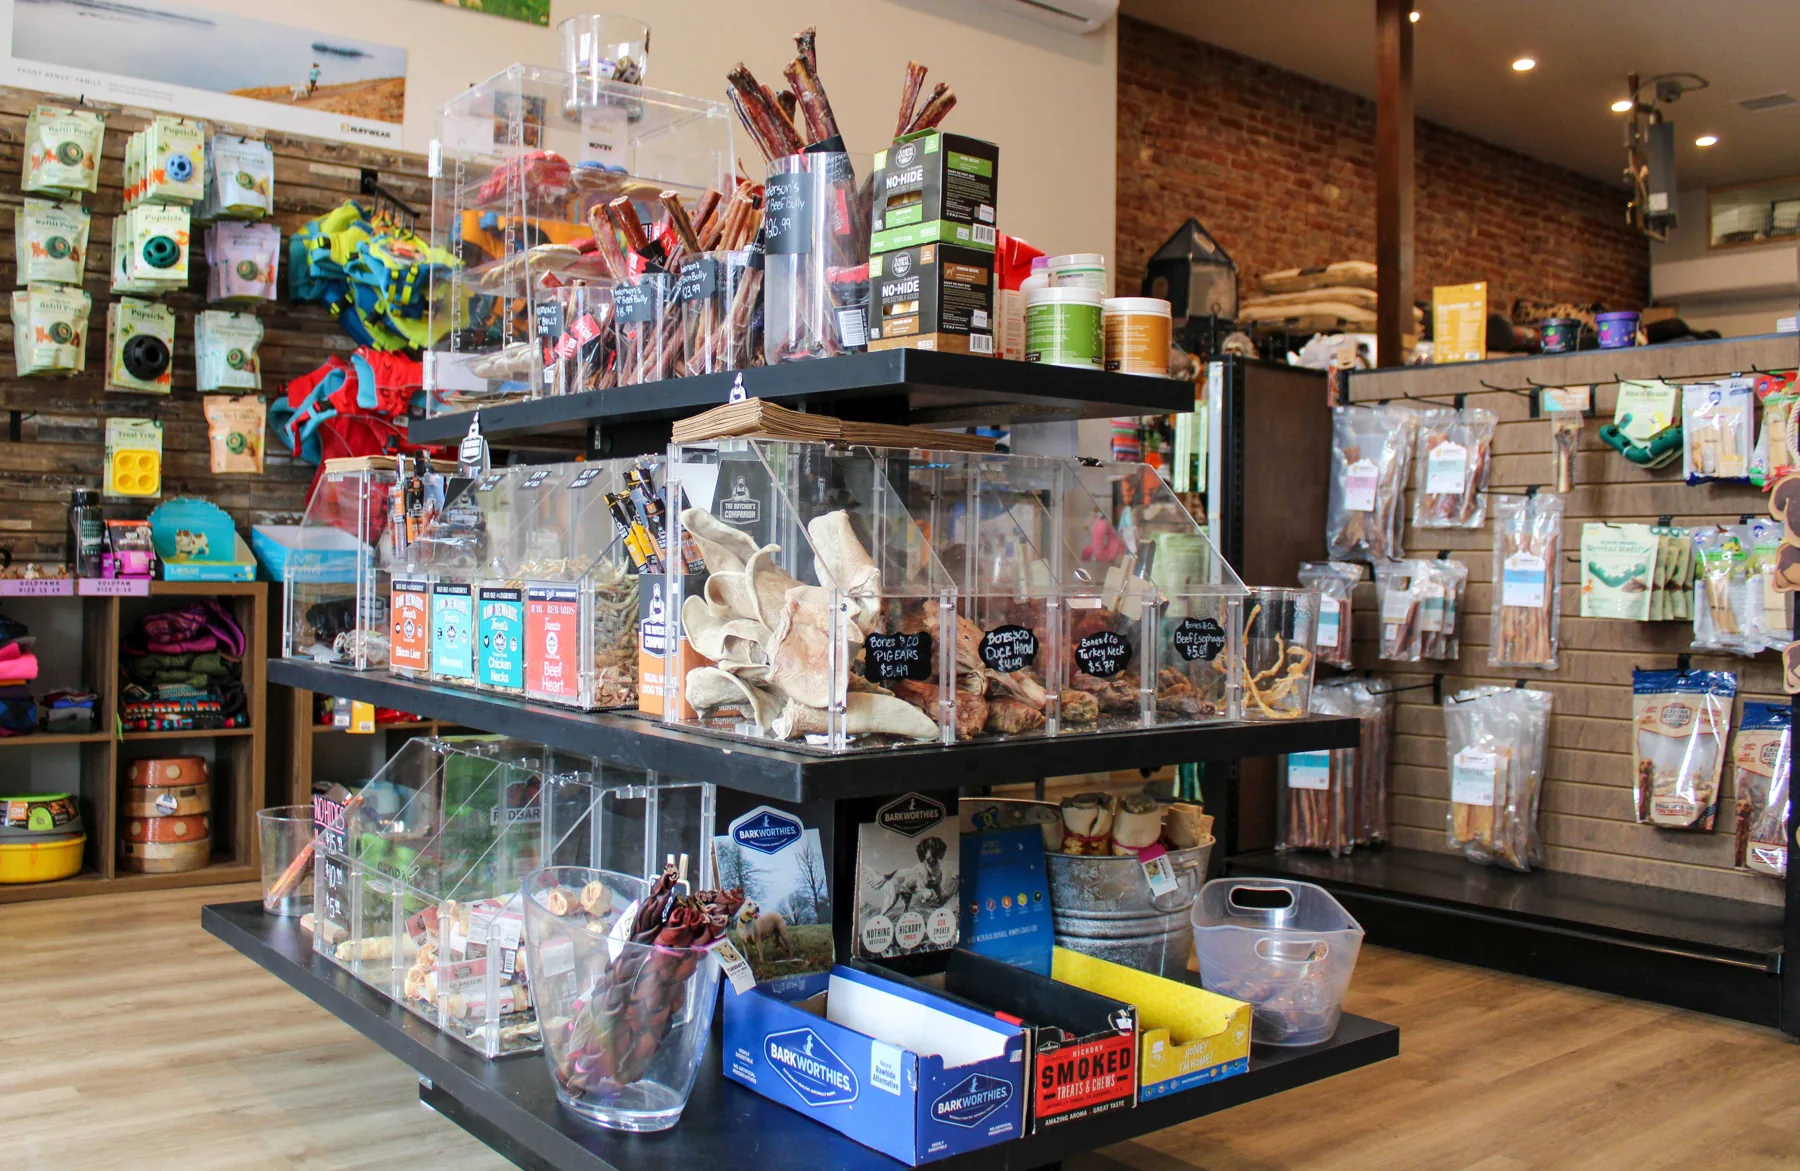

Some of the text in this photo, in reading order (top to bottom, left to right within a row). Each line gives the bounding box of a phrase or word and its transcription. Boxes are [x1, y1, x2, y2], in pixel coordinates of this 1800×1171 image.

[17, 67, 43, 77] FRONT
[75, 76, 101, 86] FAMILY
[163, 125, 198, 137] Pupsicle
[770, 196, 785, 210] Beef
[785, 196, 806, 212] Bully
[145, 214, 183, 222] Pupsicle
[633, 295, 649, 305] Bully
[131, 309, 165, 321] Pupsicle
[733, 502, 756, 510] BUTCHER'S
[724, 510, 756, 519] COMPANION
[483, 602, 518, 623] RAW REWARDS
[547, 604, 575, 615] REWARDS
[544, 617, 561, 631] Treats
[1185, 620, 1202, 630] Bones
[870, 636, 896, 648] Bones
[987, 630, 1012, 645] Bones
[1081, 638, 1103, 648] Bones
[1108, 635, 1119, 644] Co
[1176, 631, 1226, 647] Beef Esophagus
[395, 646, 421, 660] Bison Liver
[873, 650, 919, 662] PIG EARS
[985, 637, 1034, 661] Duck Head
[1078, 644, 1125, 661] Turkey Neck
[488, 656, 512, 670] Chicken
[543, 661, 562, 677] Beef
[1087, 659, 1115, 674] $5.79
[490, 669, 509, 683] Necks
[643, 672, 659, 684] REAL
[880, 664, 909, 678] $5.49
[542, 676, 564, 694] Heart
[642, 683, 655, 695] DOG
[884, 809, 939, 823] BARKWORTHIES
[739, 826, 797, 839] BARKWORTHIES
[866, 927, 891, 939] NOTHING
[899, 923, 921, 934] HICKORY
[933, 926, 950, 935] SMOKED
[1072, 1045, 1103, 1058] HICKORY
[1185, 1040, 1209, 1059] HONEY
[880, 1060, 892, 1069] Natural
[1190, 1048, 1214, 1069] HOME!
[875, 1065, 896, 1079] Rawhide
[1042, 1047, 1131, 1089] SMOKED
[872, 1073, 899, 1091] Alternative
[1057, 1081, 1083, 1101] TREATS
[1085, 1081, 1090, 1091] &
[1092, 1074, 1116, 1092] CHEWS
[1045, 1099, 1125, 1126] AMAZING AROMA GREAT TASTE
